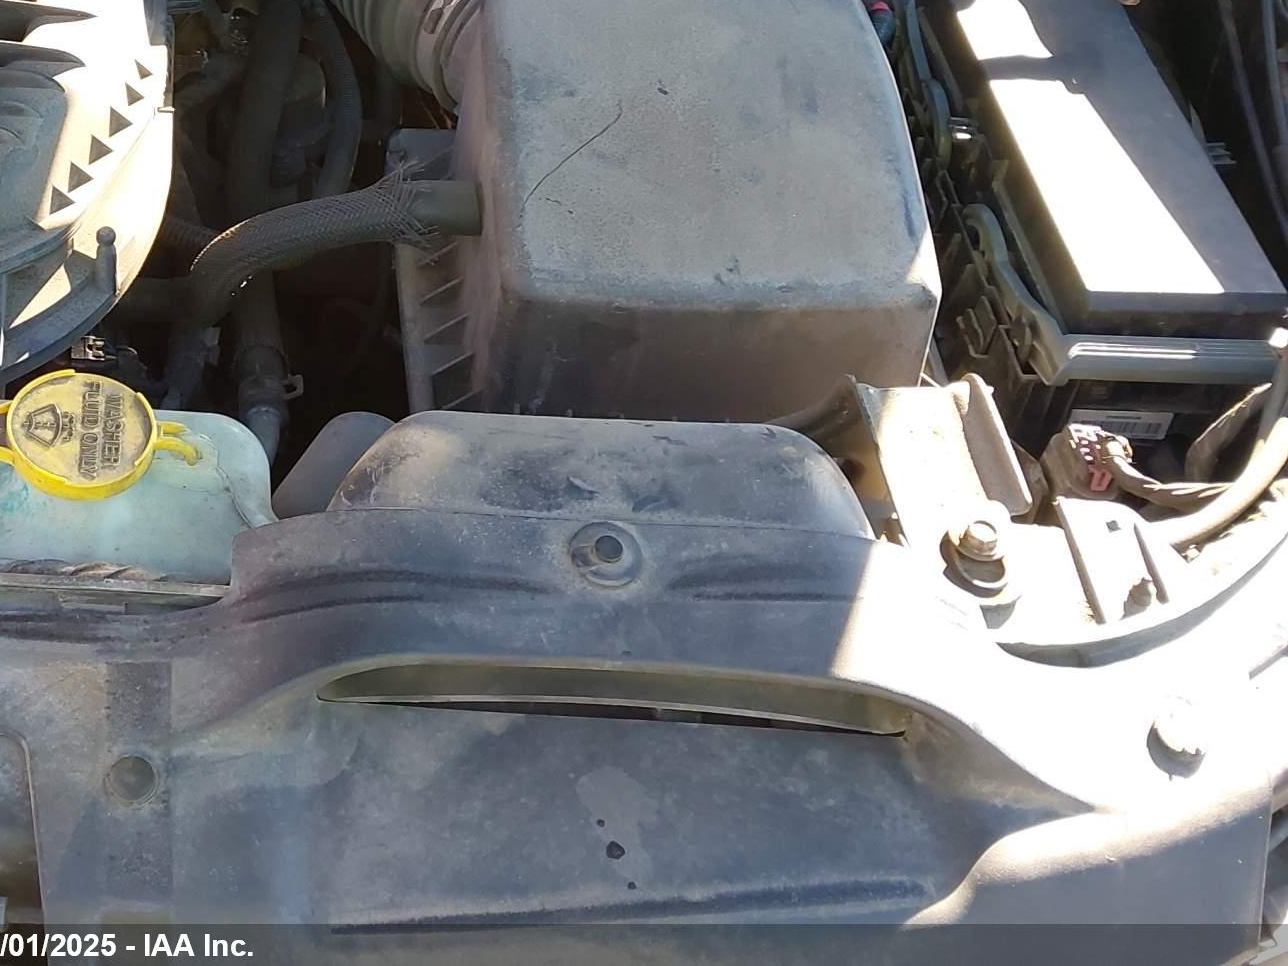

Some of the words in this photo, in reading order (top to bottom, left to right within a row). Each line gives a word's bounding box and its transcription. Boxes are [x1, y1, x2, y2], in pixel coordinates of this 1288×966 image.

[81, 381, 101, 428] FLUID
[102, 393, 123, 469] WASHER
[79, 432, 99, 480] ONLY
